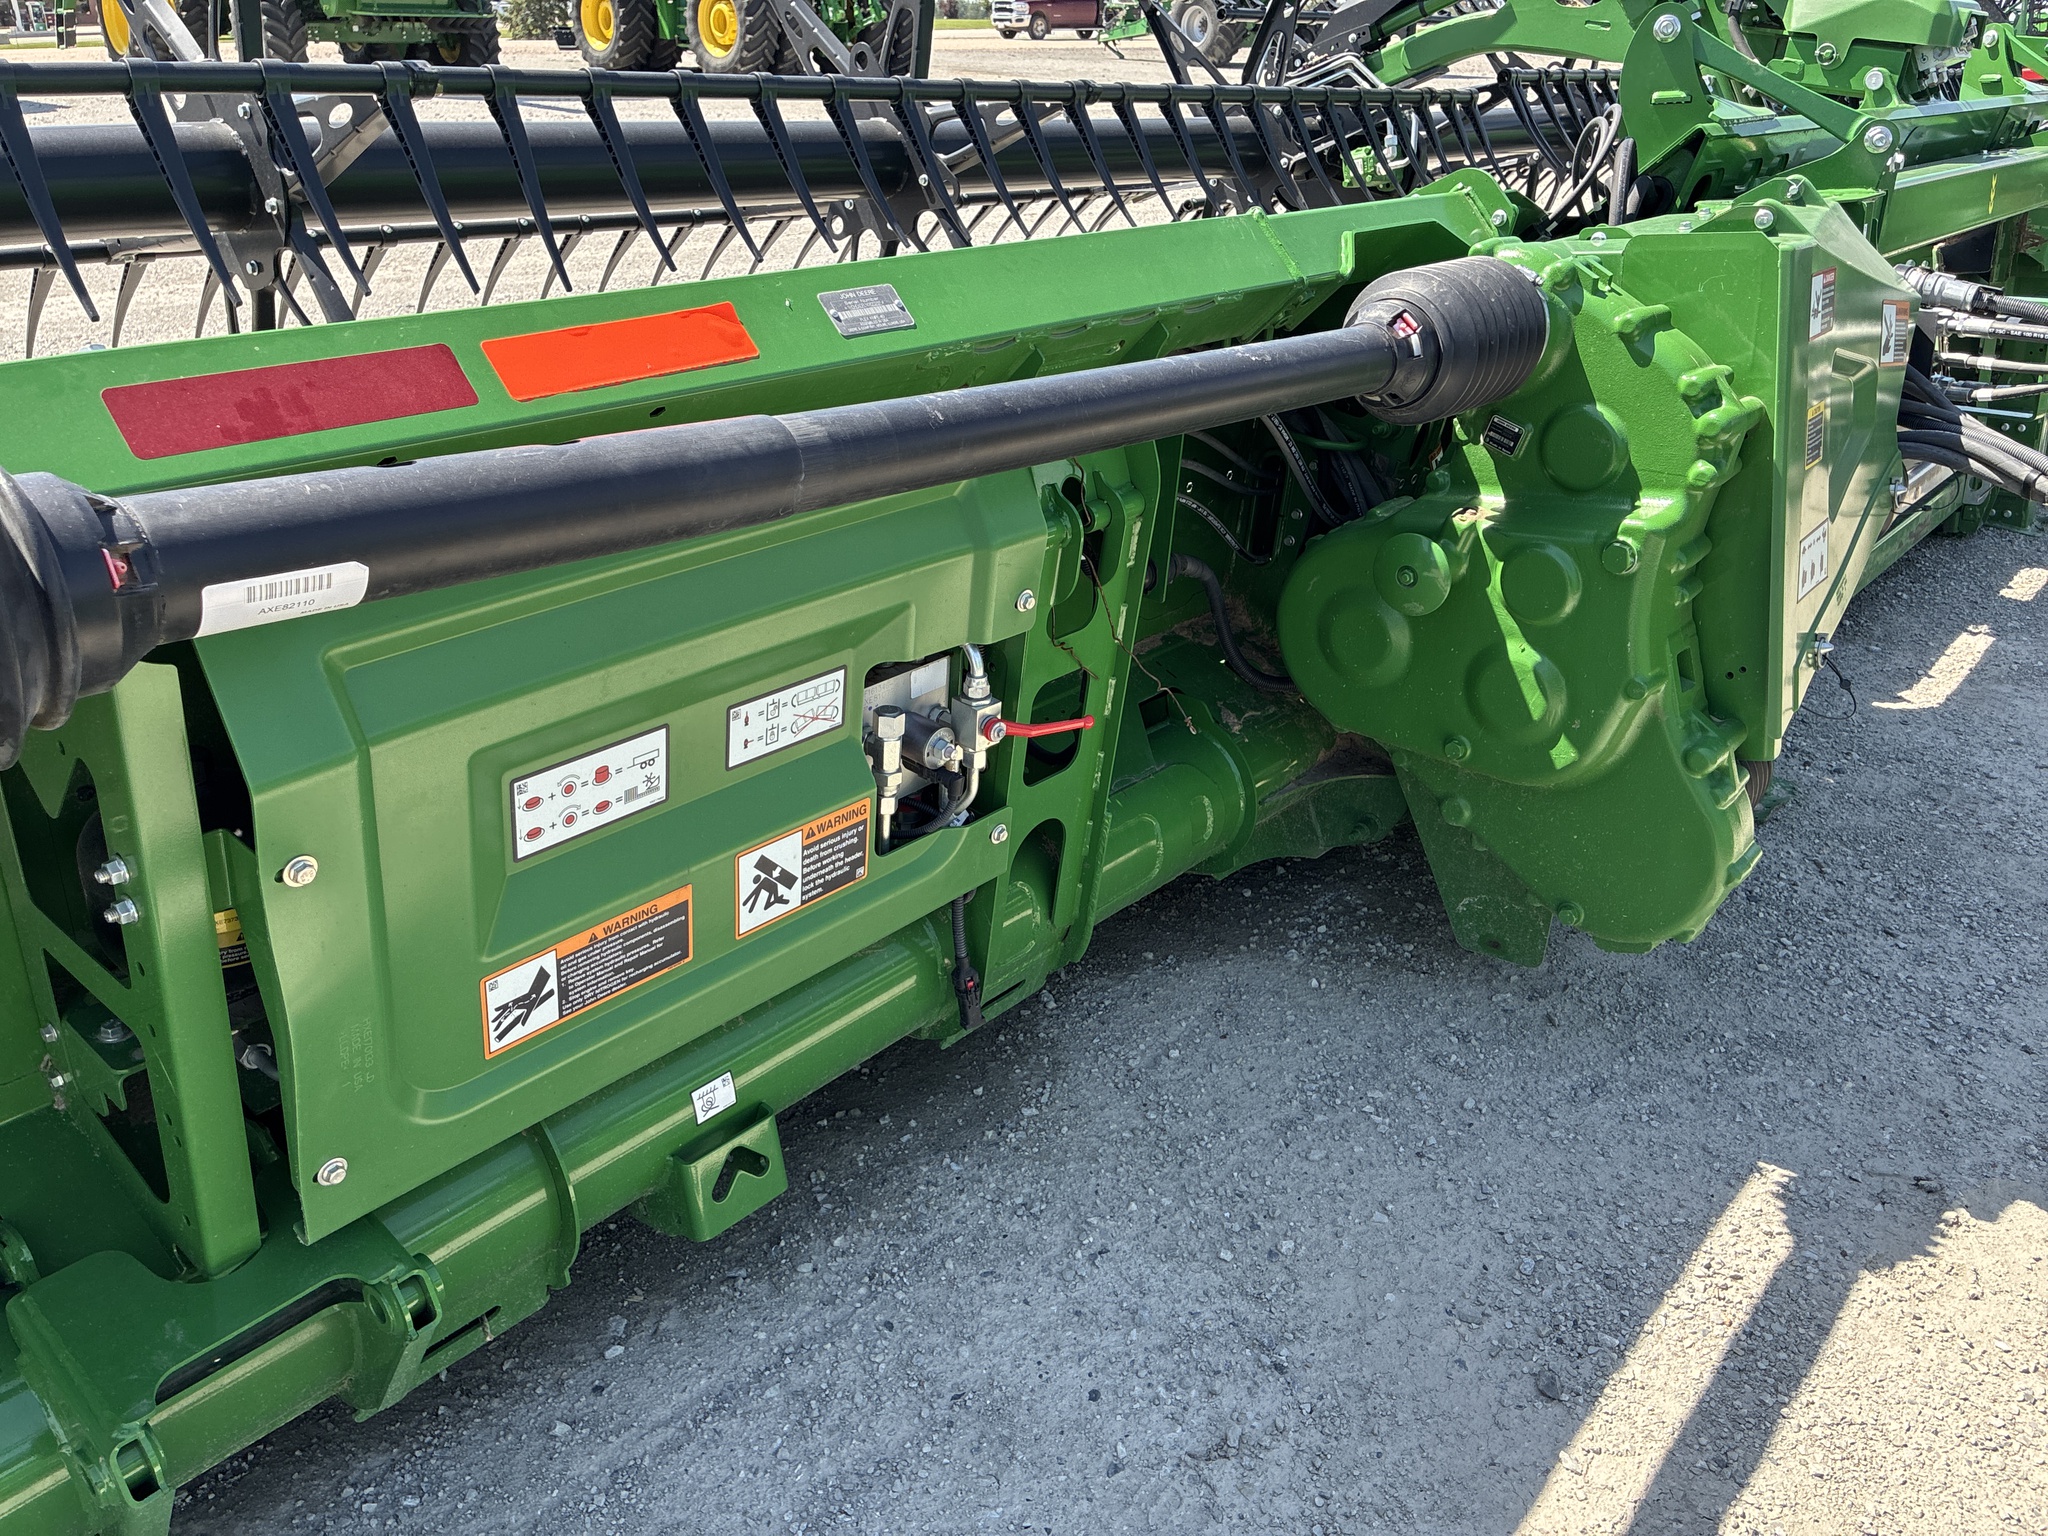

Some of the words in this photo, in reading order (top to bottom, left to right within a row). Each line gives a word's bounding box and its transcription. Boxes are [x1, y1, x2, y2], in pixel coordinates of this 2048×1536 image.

[258, 599, 315, 615] AXE82110
[816, 804, 867, 834] WARNING
[803, 844, 819, 856] Avoid
[820, 835, 840, 849] serious
[842, 827, 857, 840] injury
[803, 854, 818, 865] death
[820, 847, 832, 857] from
[834, 835, 859, 853] crushing.
[803, 861, 821, 874] Before
[823, 851, 844, 867] working
[803, 864, 834, 883] underneath
[835, 859, 843, 868] the
[803, 882, 814, 892] lock
[815, 877, 824, 886] the
[825, 865, 850, 881] hydraulic
[802, 887, 823, 901] system.
[603, 904, 658, 936] WARNING
[560, 954, 574, 964] Avoid
[575, 946, 593, 957] serious
[594, 939, 607, 950] injury
[609, 934, 619, 942] from
[620, 925, 637, 937] contact
[639, 920, 648, 928] with
[649, 911, 669, 924] hydraulic
[561, 965, 576, 976] Before
[578, 954, 600, 969] removing
[601, 944, 622, 958] hydraulic
[653, 915, 685, 934] disassembling
[568, 959, 577, 967] and
[588, 948, 601, 958] under
[568, 973, 585, 984] Relieve
[587, 965, 603, 976] system
[605, 954, 625, 968] hydraulic
[653, 936, 664, 945] Refer
[575, 974, 595, 988] Operator
[597, 965, 613, 976] Manual
[624, 953, 638, 964] Repair
[640, 945, 655, 956] Manual
[568, 965, 589, 980] changing
[573, 997, 582, 1006] only
[596, 979, 620, 994] NITROGEN
[629, 963, 653, 979] recharging
[569, 993, 580, 1002] Stop
[581, 985, 597, 996] engine
[608, 972, 624, 983] remove
[569, 984, 586, 996] system
[573, 1003, 583, 1012] your
[585, 996, 596, 1005] John
[598, 989, 610, 999] Deere
[351, 1024, 361, 1053] MADE
[353, 1057, 361, 1068] IN
[354, 1072, 363, 1092] USA
